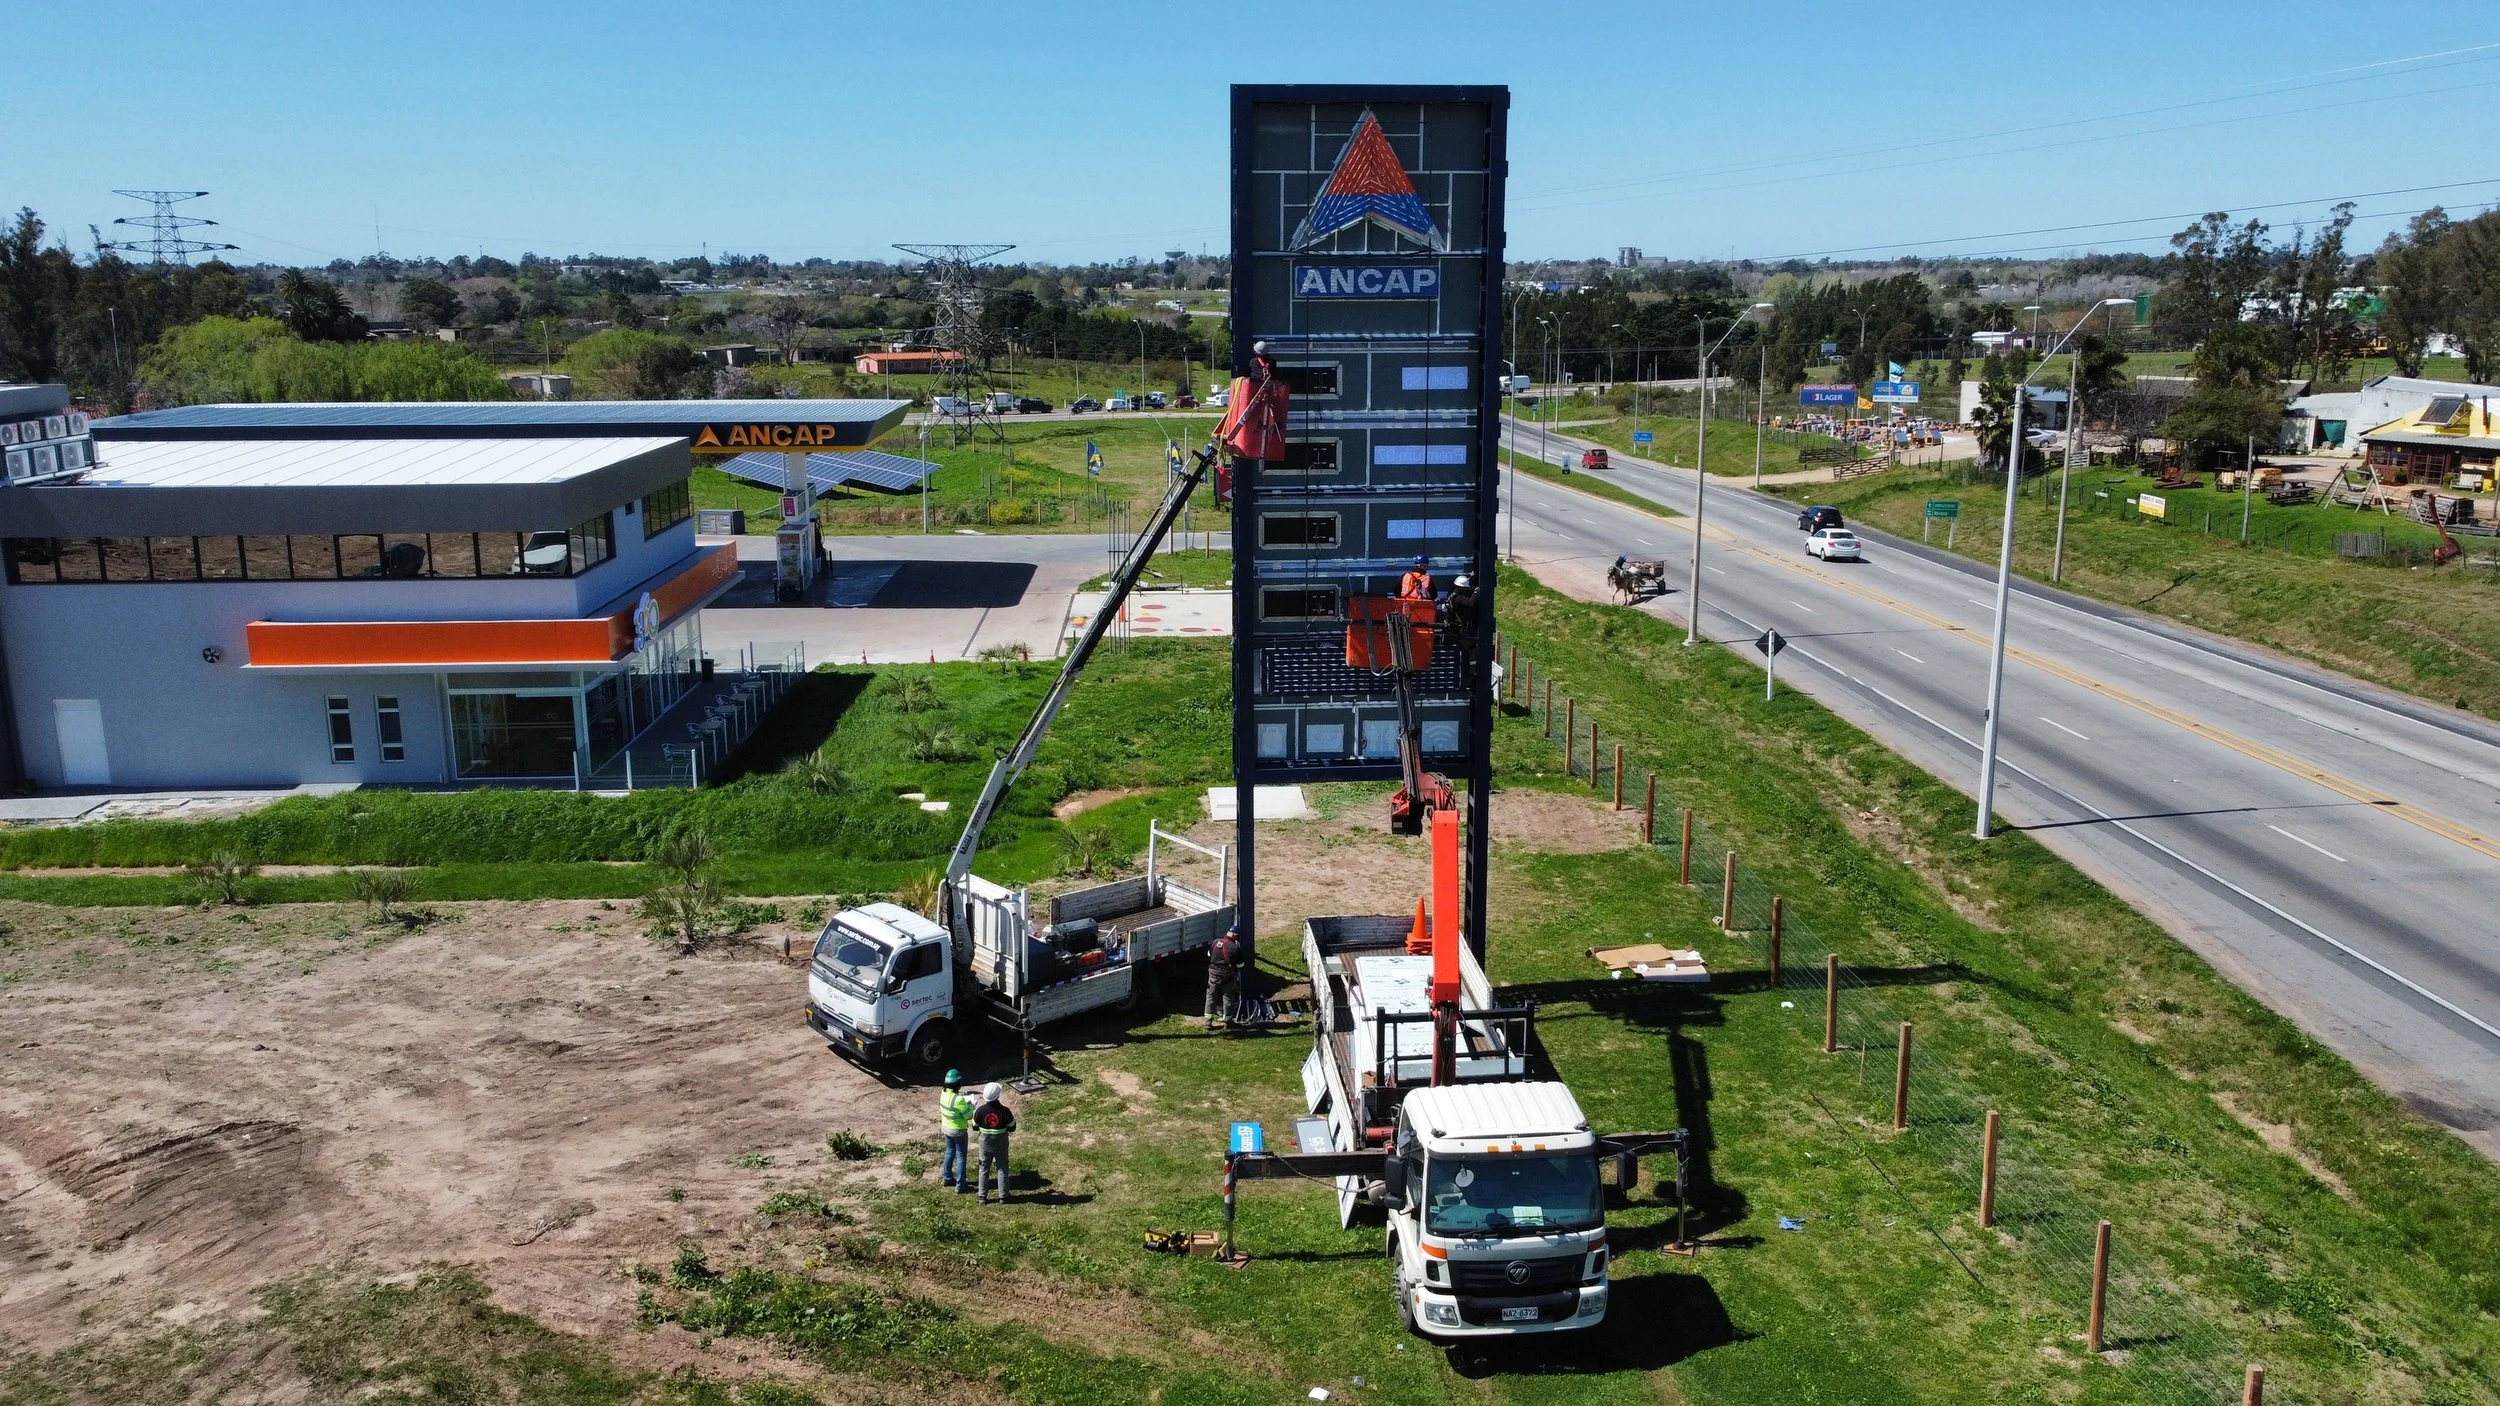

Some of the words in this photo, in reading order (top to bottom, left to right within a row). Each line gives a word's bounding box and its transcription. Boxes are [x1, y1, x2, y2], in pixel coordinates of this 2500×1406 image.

[1300, 268, 1437, 294] ANCAP
[1820, 393, 1843, 401] LAGER
[727, 423, 836, 446] ANCAP
[911, 995, 933, 1006] sertec
